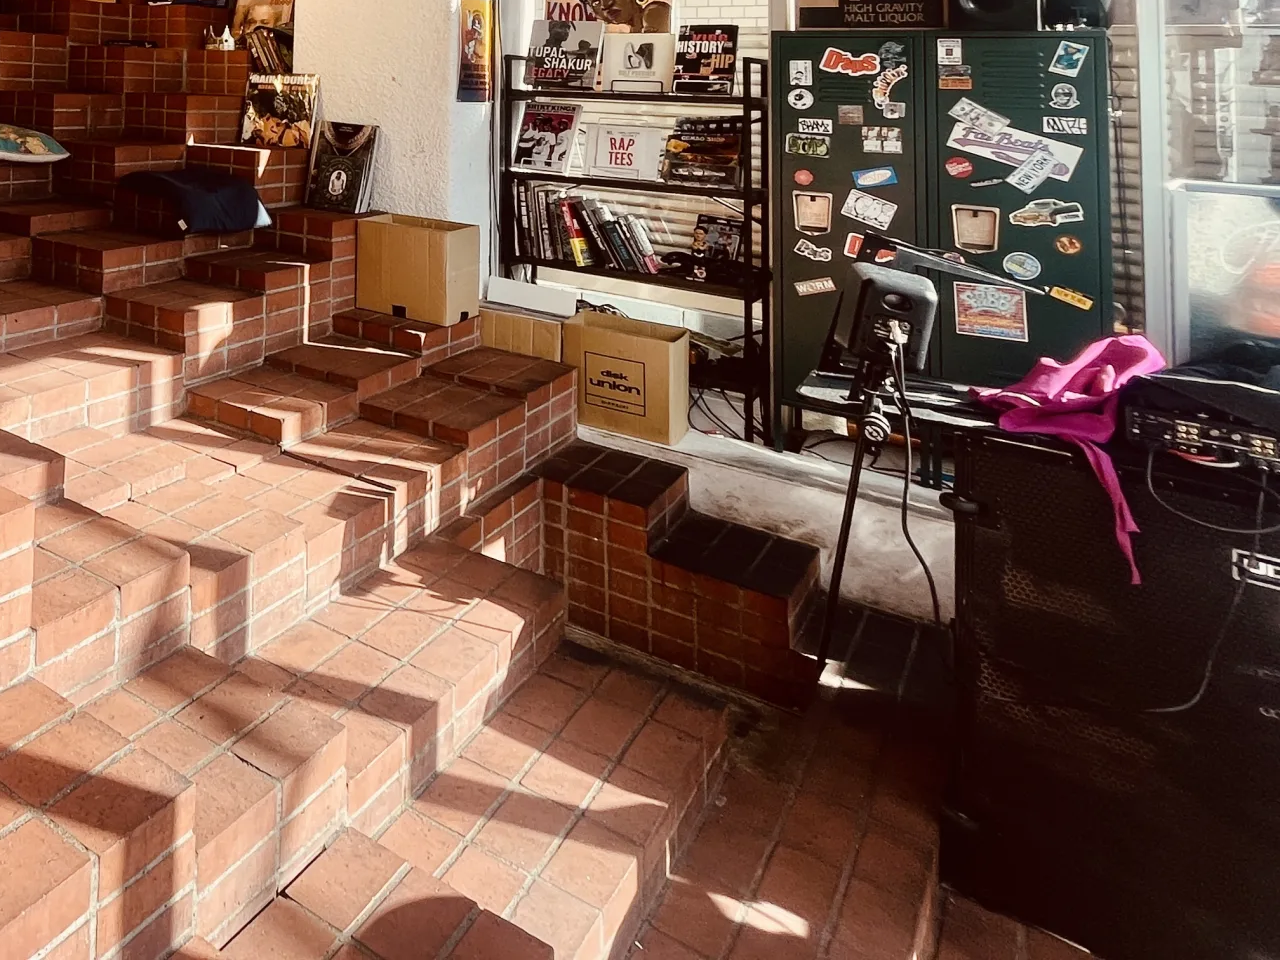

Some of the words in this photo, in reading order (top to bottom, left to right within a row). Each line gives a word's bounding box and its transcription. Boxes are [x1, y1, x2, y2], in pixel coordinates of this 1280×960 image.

[844, 3, 873, 13] HIGH
[875, 2, 925, 13] GRAVITY
[844, 13, 876, 23] MALT
[878, 12, 925, 24] LIQUOR
[529, 46, 567, 58] TUPAC
[676, 40, 725, 54] HISTORY
[543, 57, 593, 71] SHAKUR
[710, 53, 735, 69] HIP
[609, 137, 636, 152] RAP
[608, 151, 634, 167] TEES
[1014, 168, 1034, 188] NEW
[1031, 154, 1053, 176] YORK
[795, 279, 836, 294] WORM
[600, 370, 629, 382] disk
[589, 376, 641, 396] union
